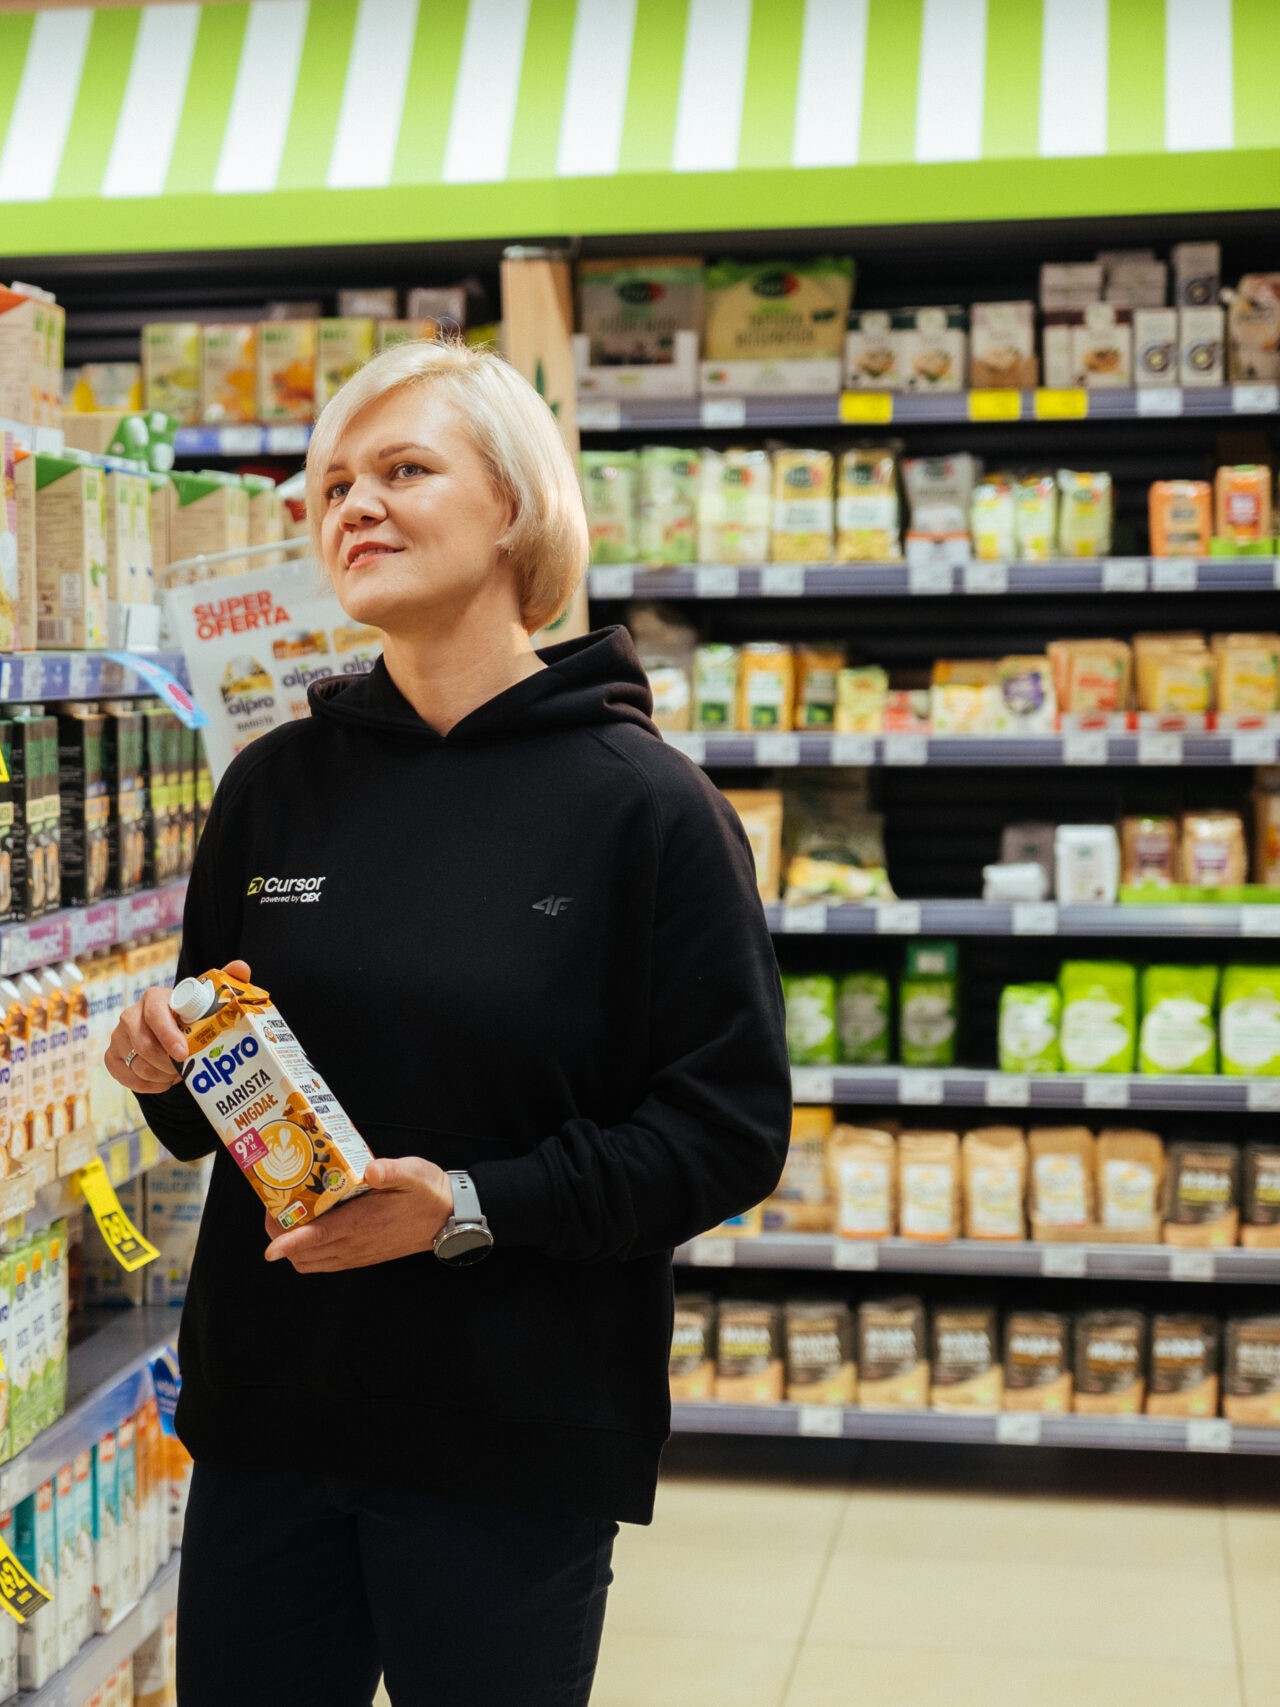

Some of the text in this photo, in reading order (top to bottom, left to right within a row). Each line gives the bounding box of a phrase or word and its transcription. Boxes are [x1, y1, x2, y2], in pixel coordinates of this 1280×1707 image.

[194, 589, 273, 619] SUPER
[197, 606, 292, 642] OFERTA
[228, 694, 275, 716] alpro
[264, 876, 326, 893] Cursor
[260, 894, 291, 904] powered
[291, 894, 300, 903] by
[532, 894, 575, 916] 4F
[192, 1035, 259, 1094] alpro
[216, 1069, 273, 1117] BARISTA
[233, 1093, 280, 1132] MIGDAŁ
[234, 1140, 248, 1160] 9
